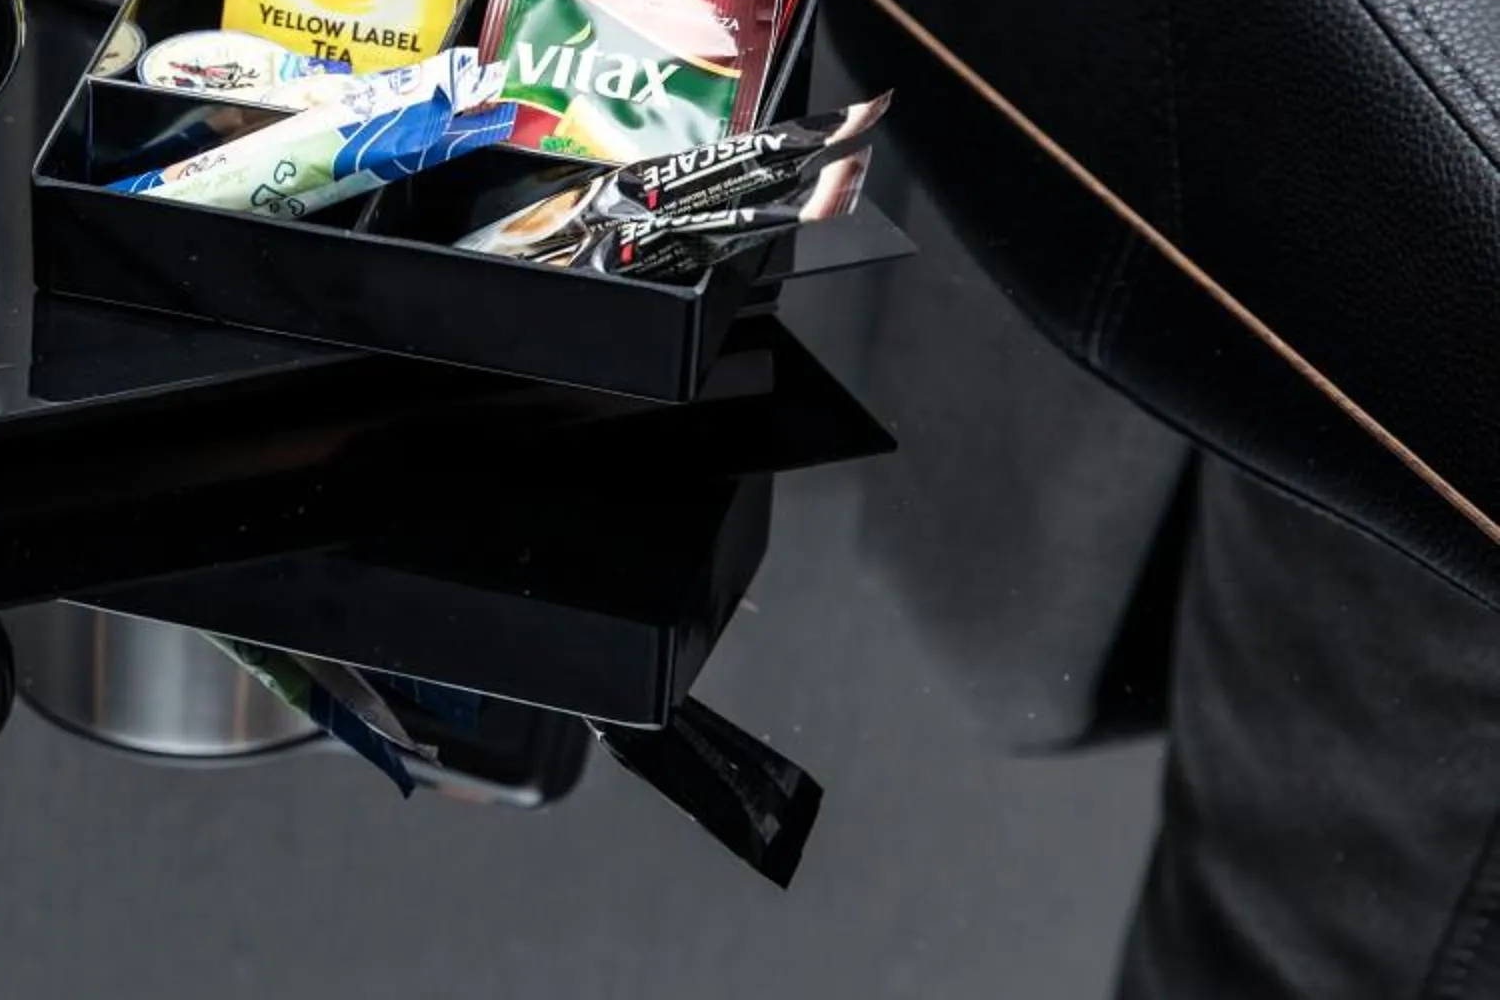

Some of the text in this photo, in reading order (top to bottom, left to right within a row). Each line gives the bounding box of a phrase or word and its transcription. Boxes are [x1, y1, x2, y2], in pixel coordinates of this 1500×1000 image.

[260, 4, 421, 53] YELLOW LABEL
[312, 39, 352, 64] TEA
[516, 26, 681, 107] vitax
